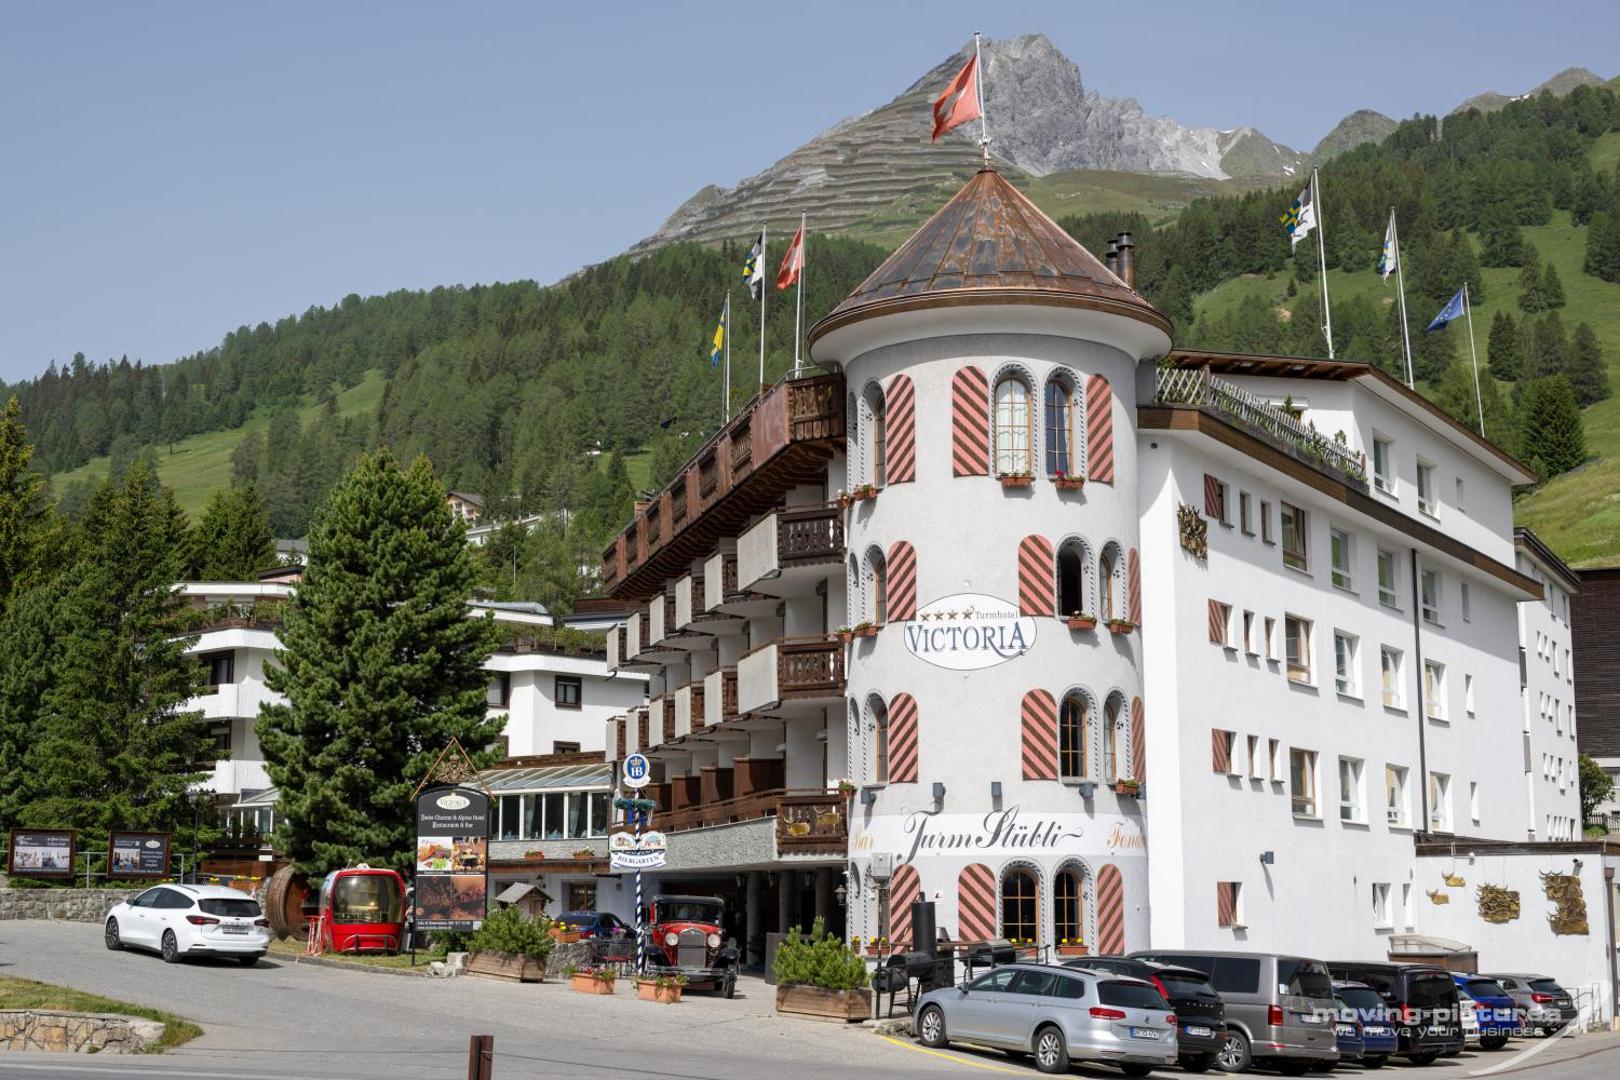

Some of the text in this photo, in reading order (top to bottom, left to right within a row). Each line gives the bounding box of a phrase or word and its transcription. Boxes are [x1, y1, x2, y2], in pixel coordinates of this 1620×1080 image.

[975, 608, 1018, 619] Turmhotel
[631, 766, 643, 777] HB
[617, 854, 660, 865] BIERGARTEN
